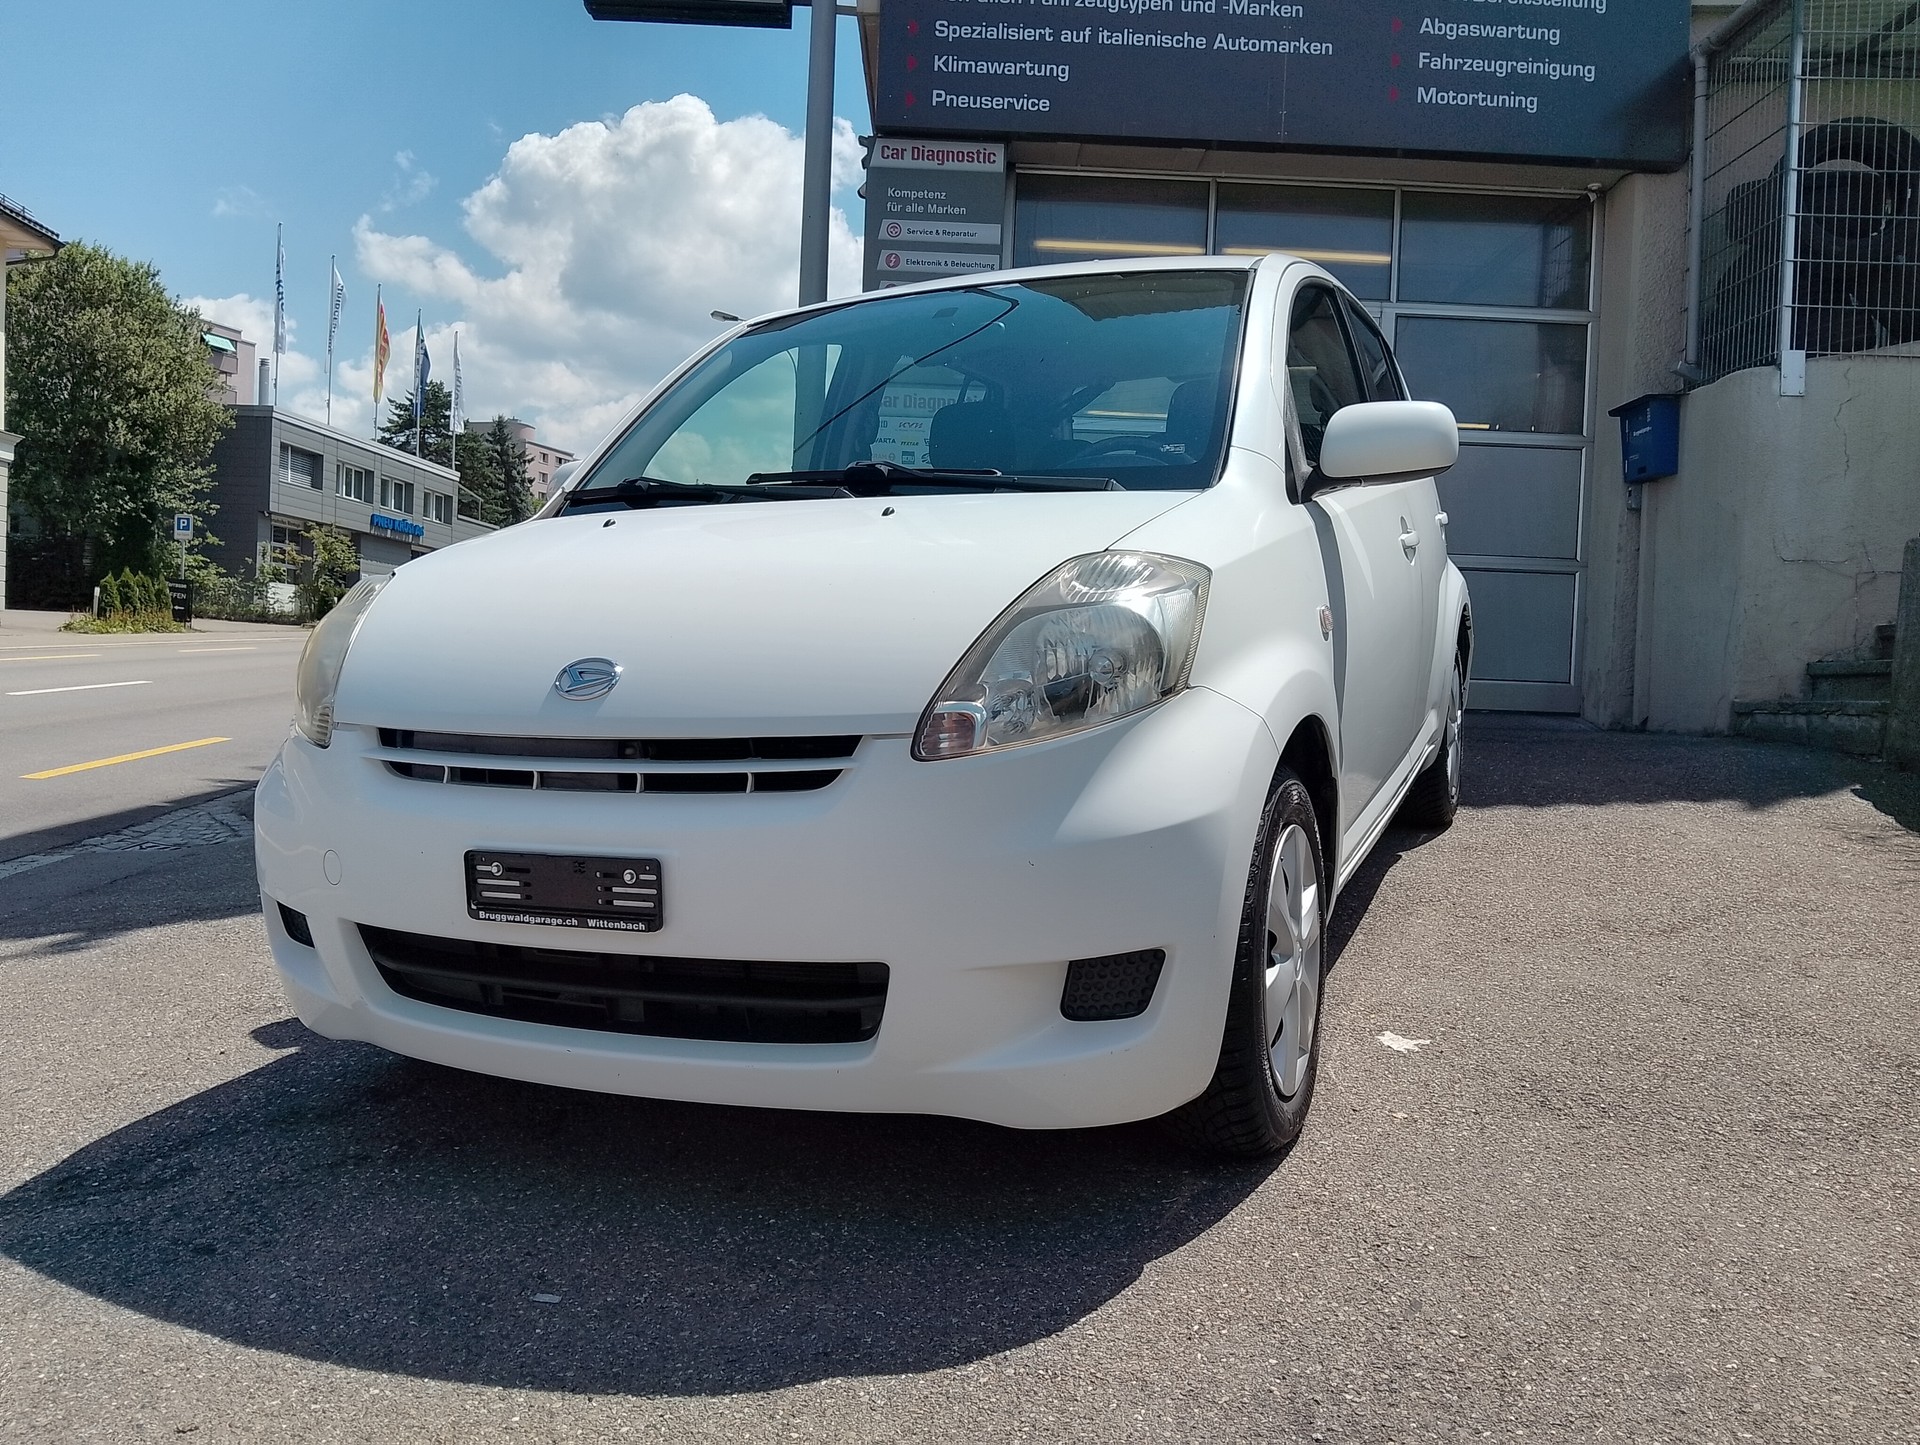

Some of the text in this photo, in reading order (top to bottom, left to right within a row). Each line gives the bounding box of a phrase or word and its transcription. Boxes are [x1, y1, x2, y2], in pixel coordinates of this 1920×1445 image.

[1030, 0, 1304, 18] zeugtypen und -Marken
[935, 20, 1333, 55] Spezialisiert auf italienische Automarken
[1419, 17, 1561, 45] Abgaswartung
[933, 55, 1070, 82] Klimawartung
[1418, 52, 1596, 82] Fahrzeugreinigung
[932, 89, 1050, 111] Pneuservice
[1417, 86, 1538, 113] Motortuning
[881, 145, 997, 166] Car Diagnostic
[887, 187, 947, 200] Kompetenz
[886, 202, 967, 215] für alle Marken
[906, 228, 934, 236] Service
[942, 229, 978, 238] Reparatur
[905, 258, 942, 267] Elektronik
[950, 261, 995, 270] Beleuchtung
[883, 395, 900, 408] ar
[180, 519, 188, 530] P
[169, 591, 187, 600] FFEN
[479, 911, 646, 931] Bruggwaldgarage.ch Wittenbach
